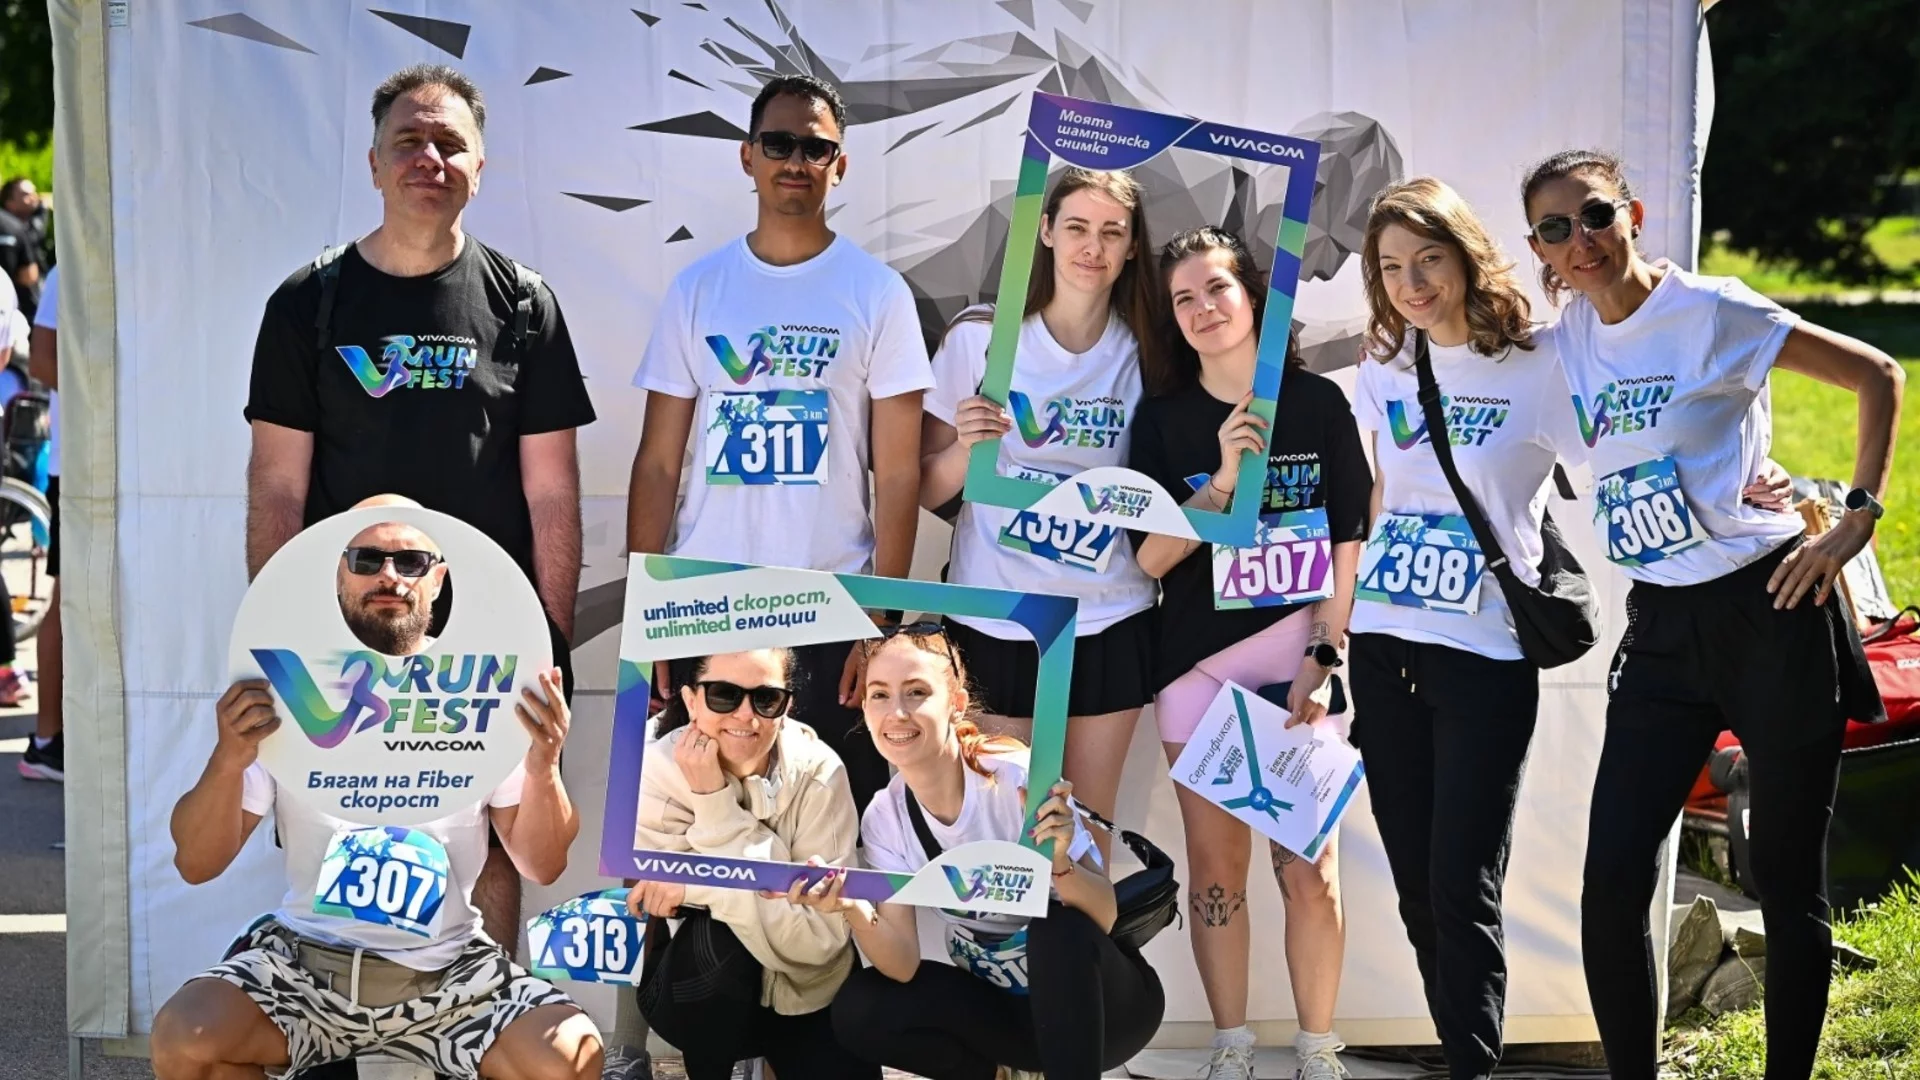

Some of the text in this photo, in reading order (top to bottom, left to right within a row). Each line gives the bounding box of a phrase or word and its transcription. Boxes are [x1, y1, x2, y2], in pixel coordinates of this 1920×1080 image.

[1059, 109, 1113, 129] Моята
[1055, 138, 1109, 156] снимка
[1057, 125, 1151, 149] шампионска
[1208, 132, 1305, 160] VIVACOM
[417, 334, 477, 345] VIVACOM
[781, 324, 840, 335] VIVACOM
[415, 345, 478, 369] RUN
[777, 335, 840, 358] RUN
[406, 368, 470, 389] FEST
[768, 357, 830, 378] FEST
[1617, 374, 1676, 386] VIVACOM
[1453, 395, 1511, 406] VIVACOM
[1616, 385, 1675, 413] RUN
[802, 410, 823, 420] 3 km
[1072, 407, 1125, 428] RUN
[1448, 405, 1509, 428] RUN
[1609, 407, 1662, 436] FEST
[741, 422, 804, 474] 311
[1062, 428, 1120, 449] FEST
[1447, 427, 1493, 447] EST
[1268, 452, 1319, 462] IVACOM
[1264, 463, 1321, 487] RUN
[1110, 503, 1146, 518] FEST
[1116, 491, 1152, 508] RUN
[1611, 492, 1687, 556] 308
[1461, 538, 1467, 548] 3
[1238, 541, 1317, 597] 507
[1383, 542, 1469, 601] 398
[643, 590, 832, 621] unlimited скорост,
[645, 610, 817, 640] unlimited емоции
[398, 654, 518, 693] RUN
[382, 698, 501, 734] FEST
[383, 740, 486, 752] VIVACOM
[1188, 713, 1237, 785] Сертификат
[307, 770, 475, 789] Бягам на Fiber
[340, 790, 440, 813] скорост
[633, 857, 756, 882] VIVACOM
[990, 871, 1034, 889] RUN
[345, 856, 435, 921] 307
[984, 886, 1026, 902] FEST
[561, 916, 628, 972] 313
[976, 955, 1028, 988] 31
